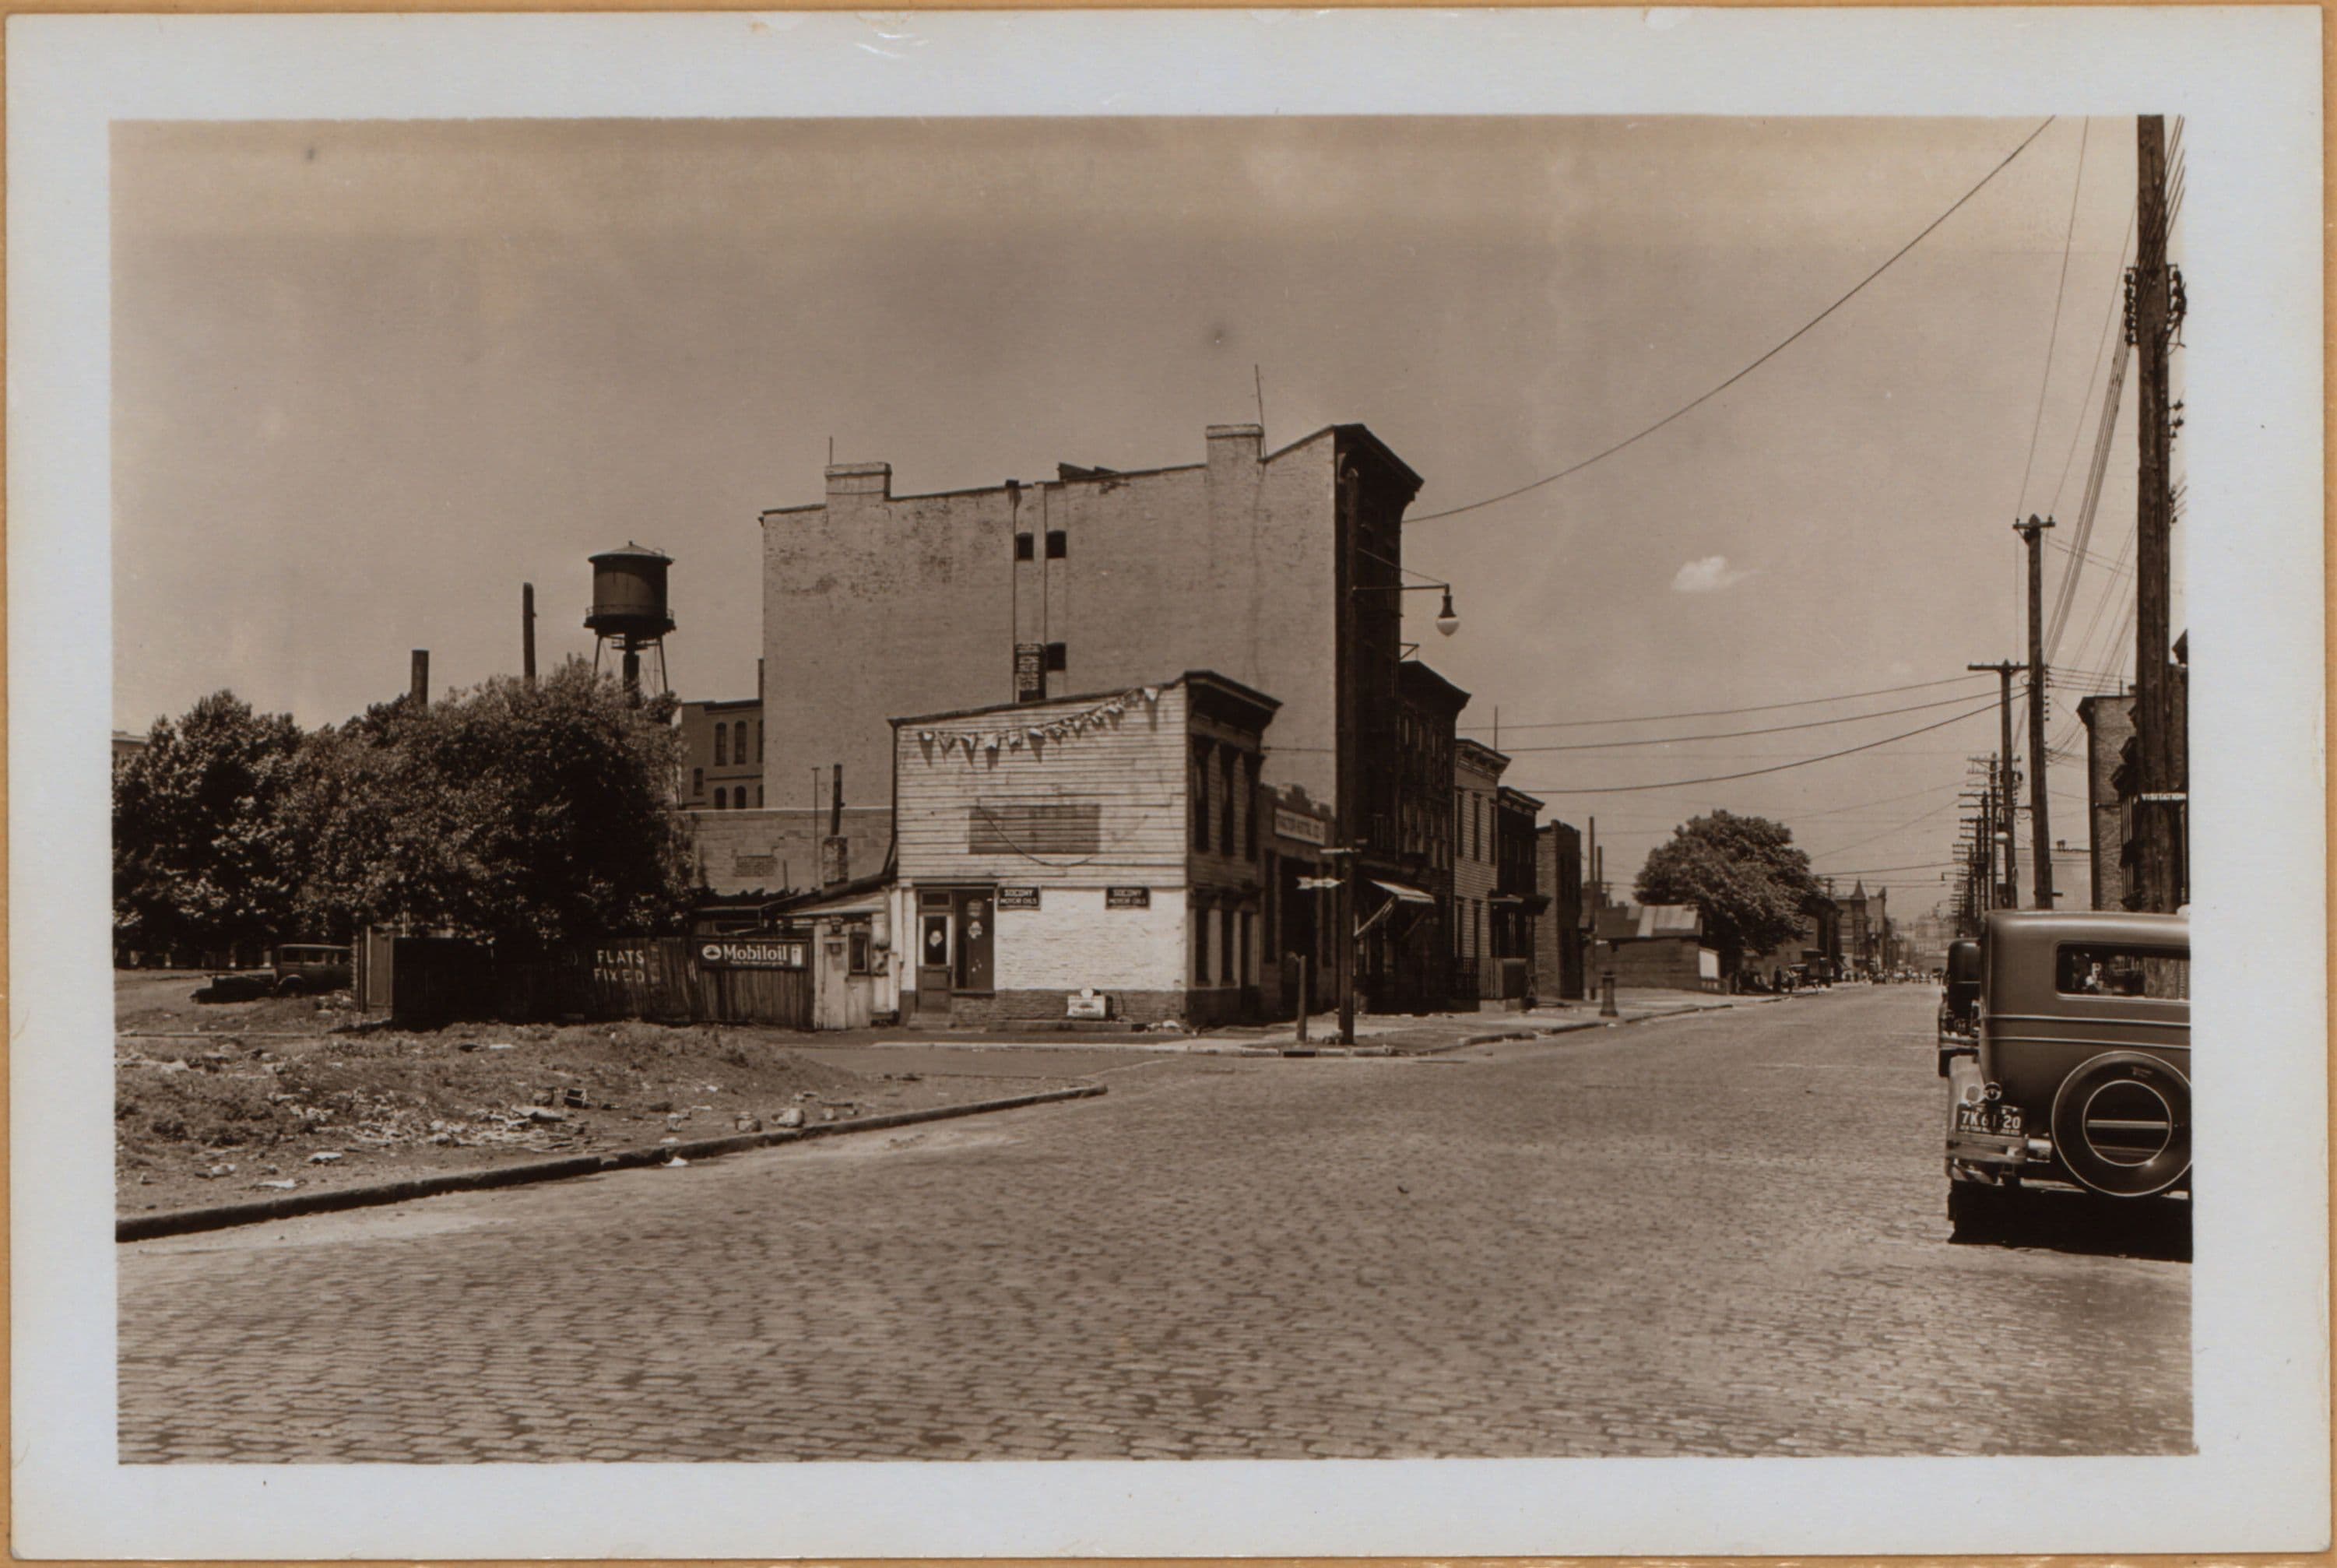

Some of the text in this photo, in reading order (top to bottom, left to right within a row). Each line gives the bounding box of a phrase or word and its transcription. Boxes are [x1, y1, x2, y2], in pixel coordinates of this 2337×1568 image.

[596, 949, 645, 965] FLATS
[722, 944, 788, 961] Mobiloil
[593, 968, 646, 983] FIXED
